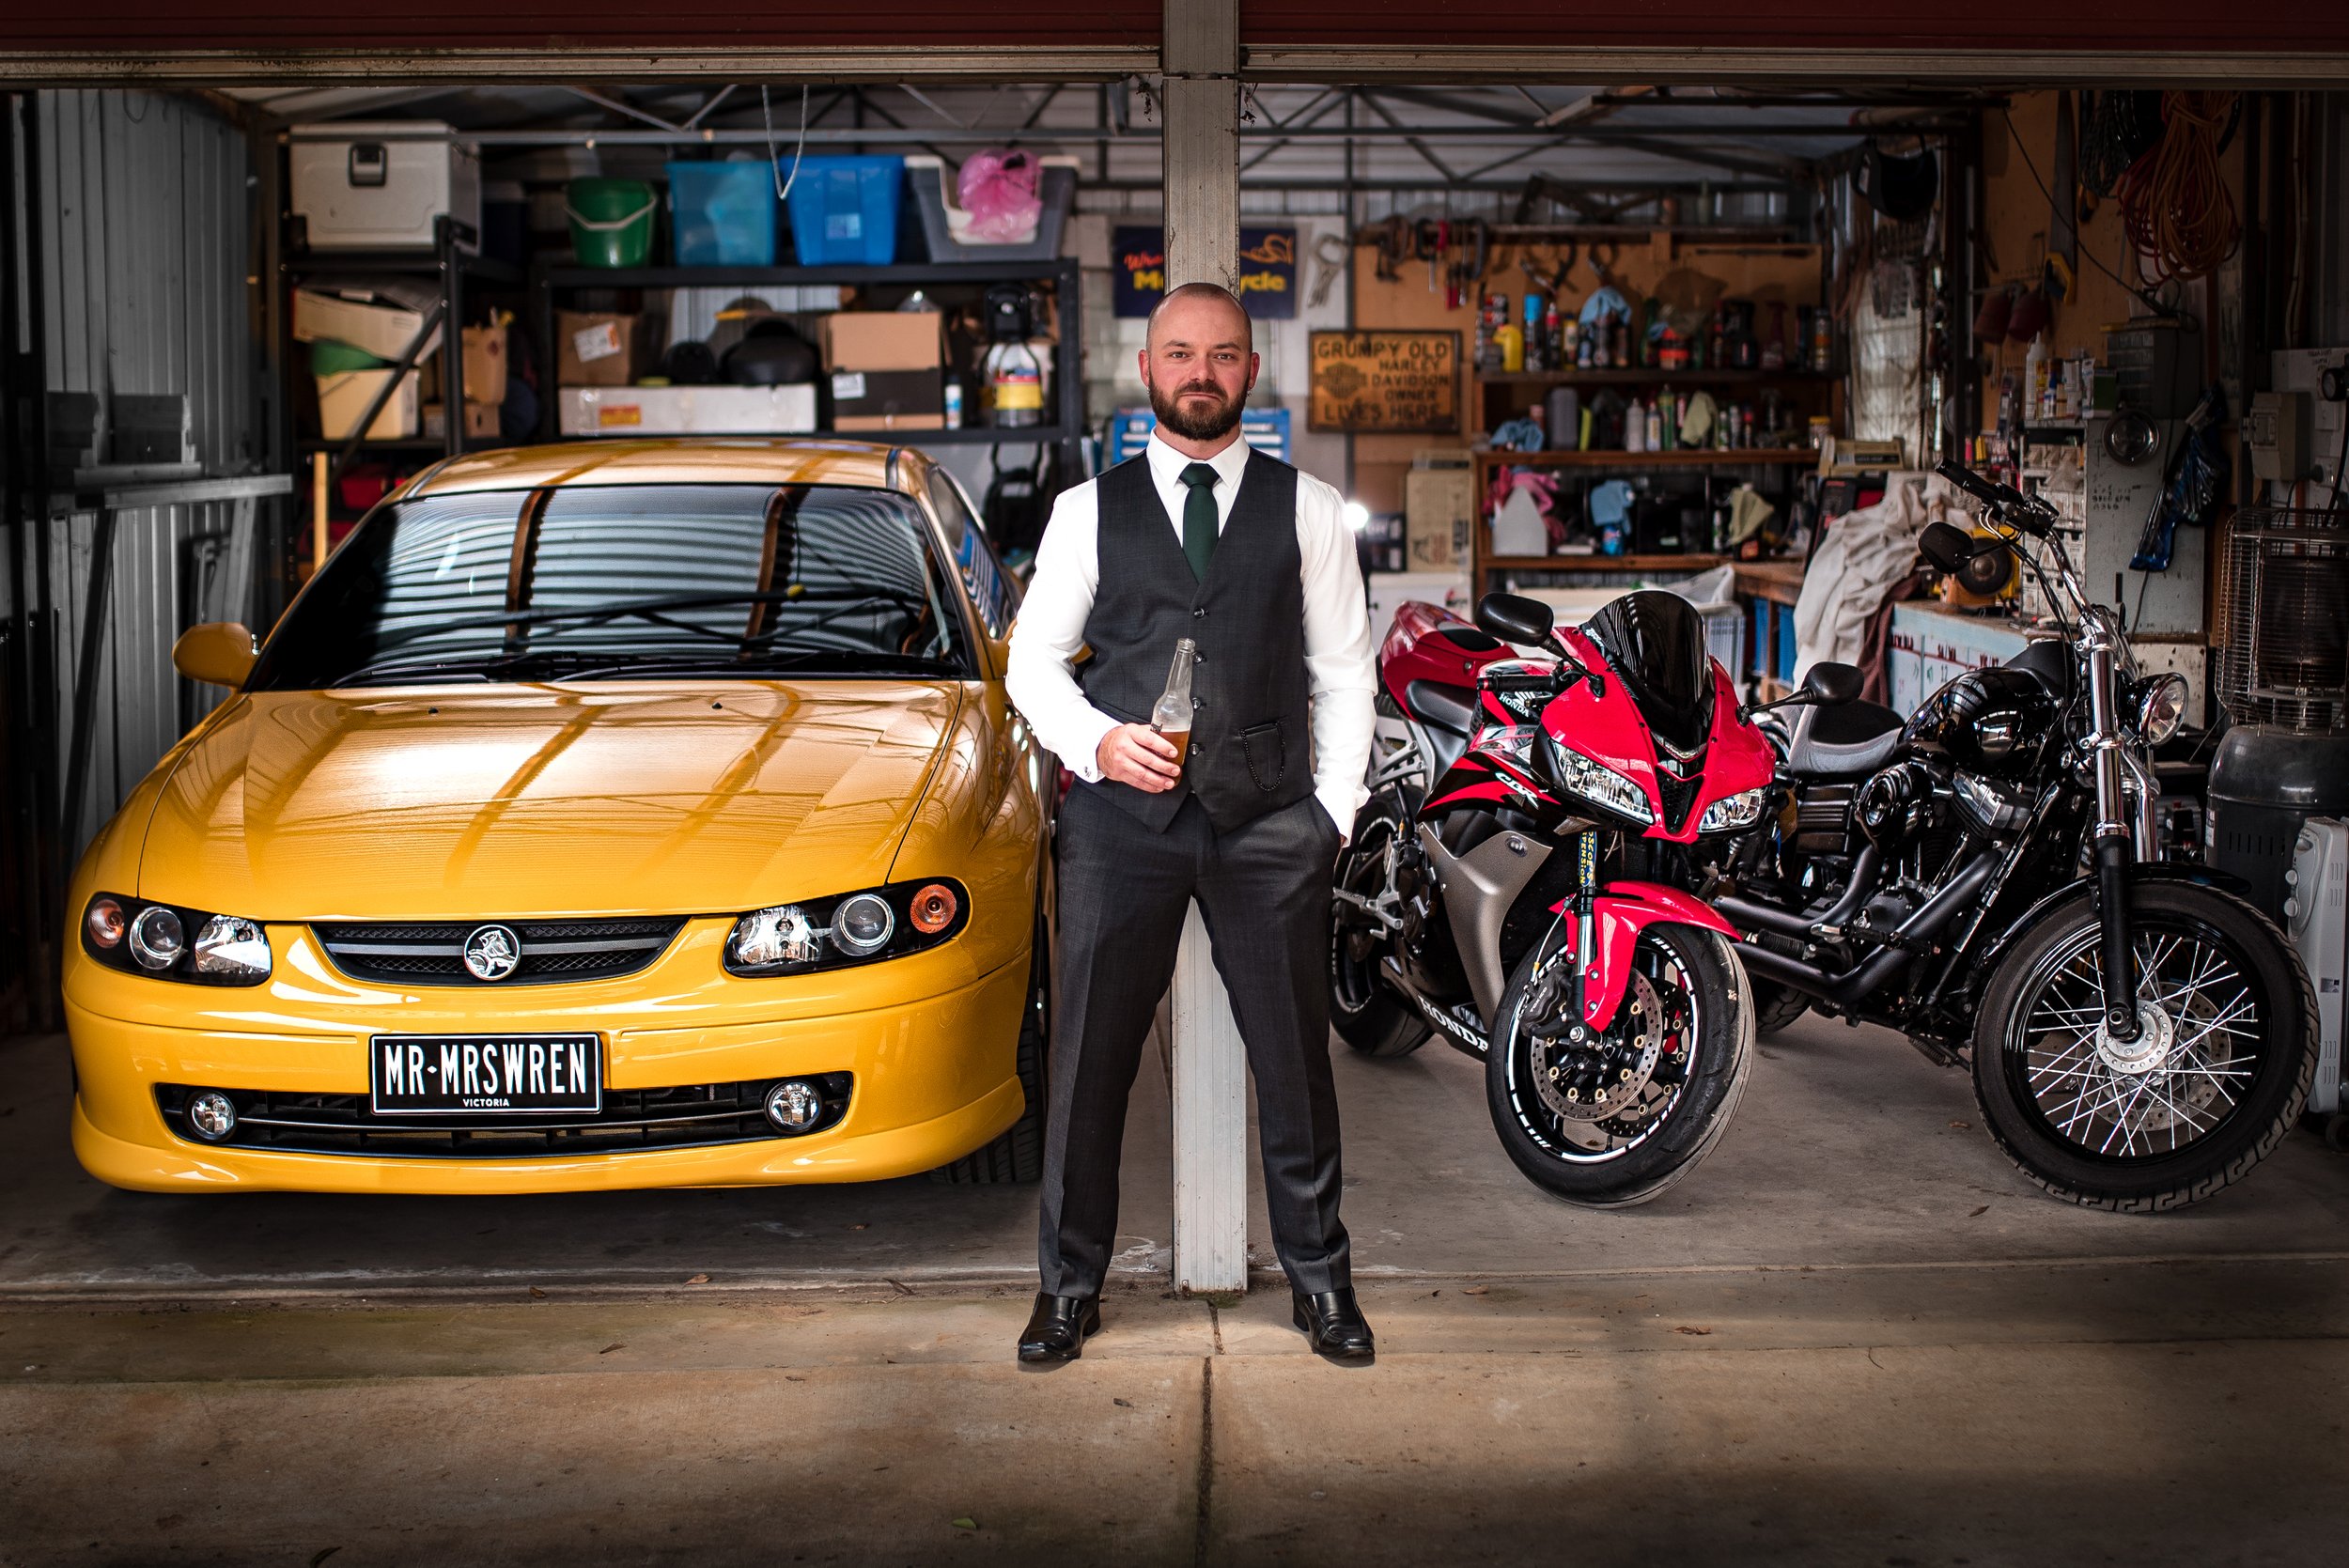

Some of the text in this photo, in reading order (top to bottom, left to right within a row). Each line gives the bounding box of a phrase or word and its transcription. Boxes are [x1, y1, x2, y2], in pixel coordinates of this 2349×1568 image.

[1317, 340, 1448, 359] GRUMPY OLD
[1378, 359, 1439, 372] HARLEY
[1371, 373, 1449, 387] DAVIDSON
[1384, 388, 1437, 401] OWNER
[1498, 691, 1530, 718] HONDA
[1494, 770, 1539, 811] CBR
[462, 1097, 510, 1108] VICTORIA
